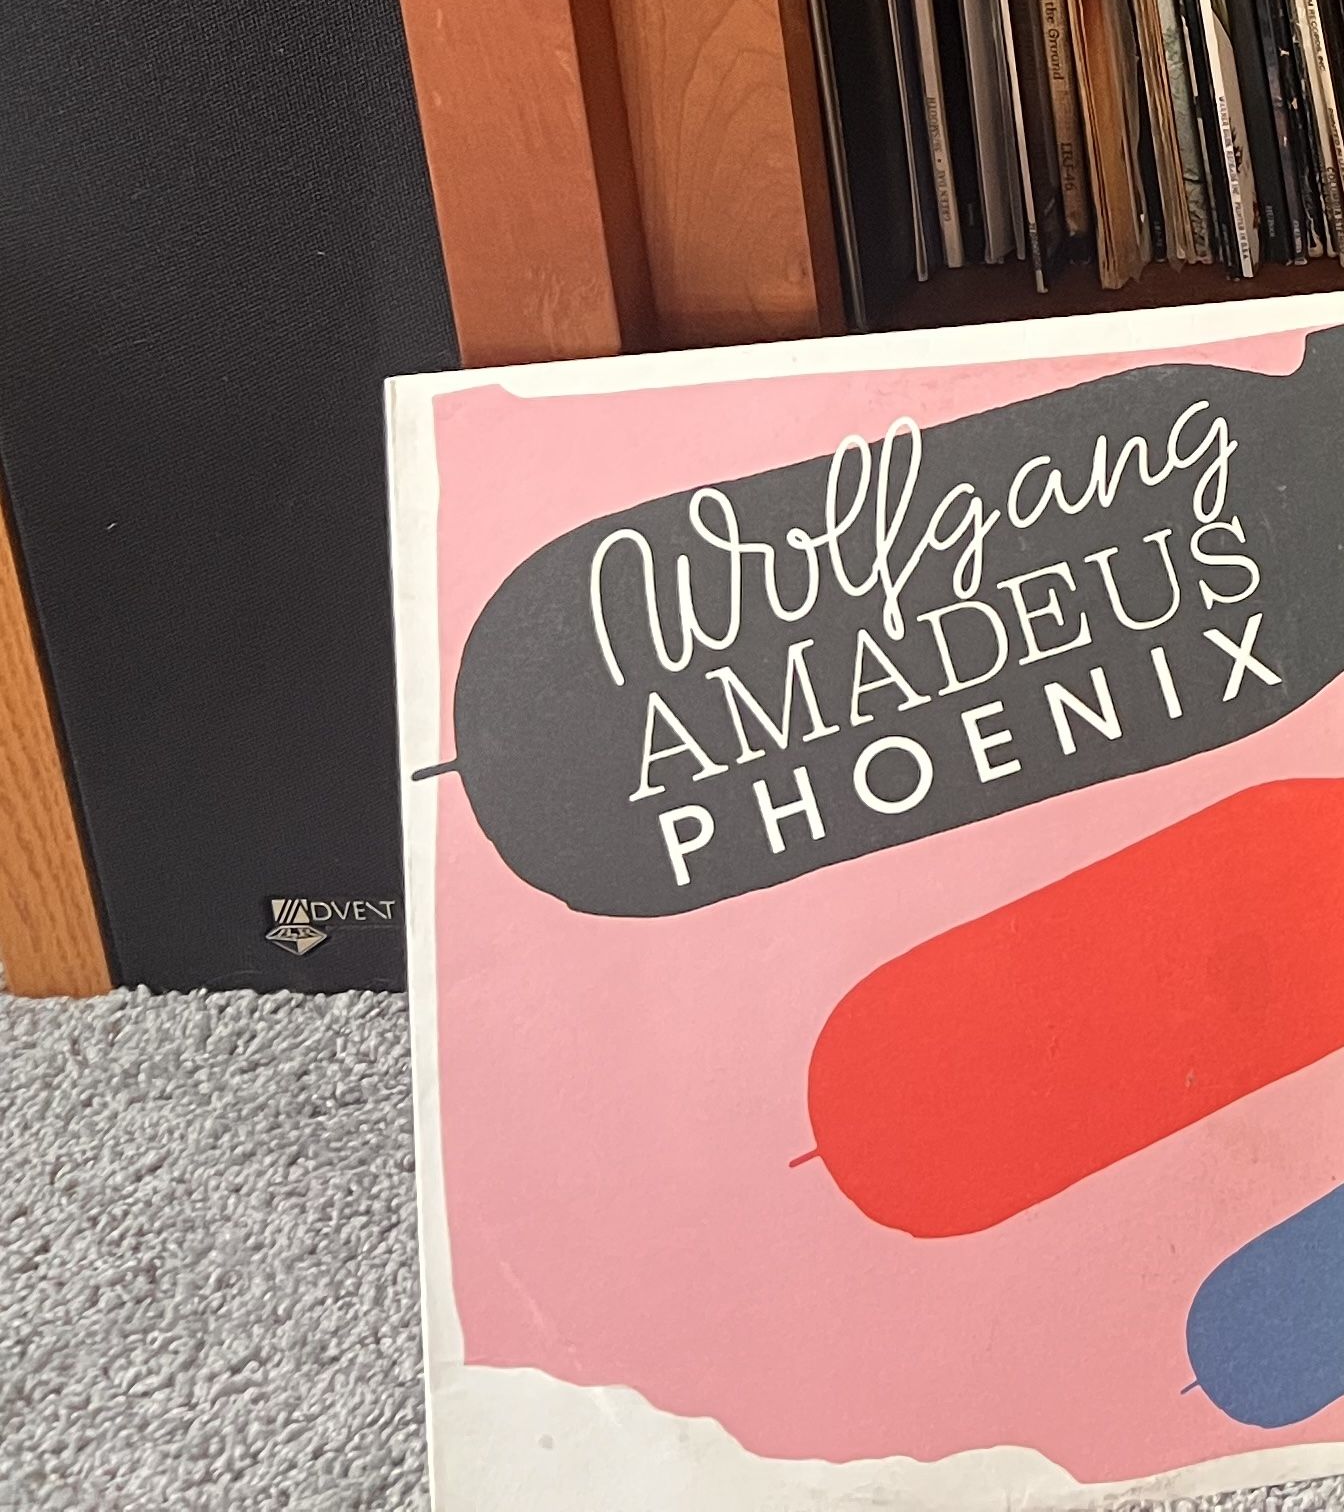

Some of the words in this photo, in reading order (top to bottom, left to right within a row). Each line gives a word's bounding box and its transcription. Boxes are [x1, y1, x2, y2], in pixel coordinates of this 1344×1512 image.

[1043, 0, 1058, 24] the
[1046, 26, 1064, 80] Ground
[936, 168, 947, 187] DAY
[938, 189, 951, 222] GREEN
[589, 399, 1238, 687] Wolfgang
[627, 515, 1262, 803] AMADEUS
[657, 612, 1282, 886] PHOENIX
